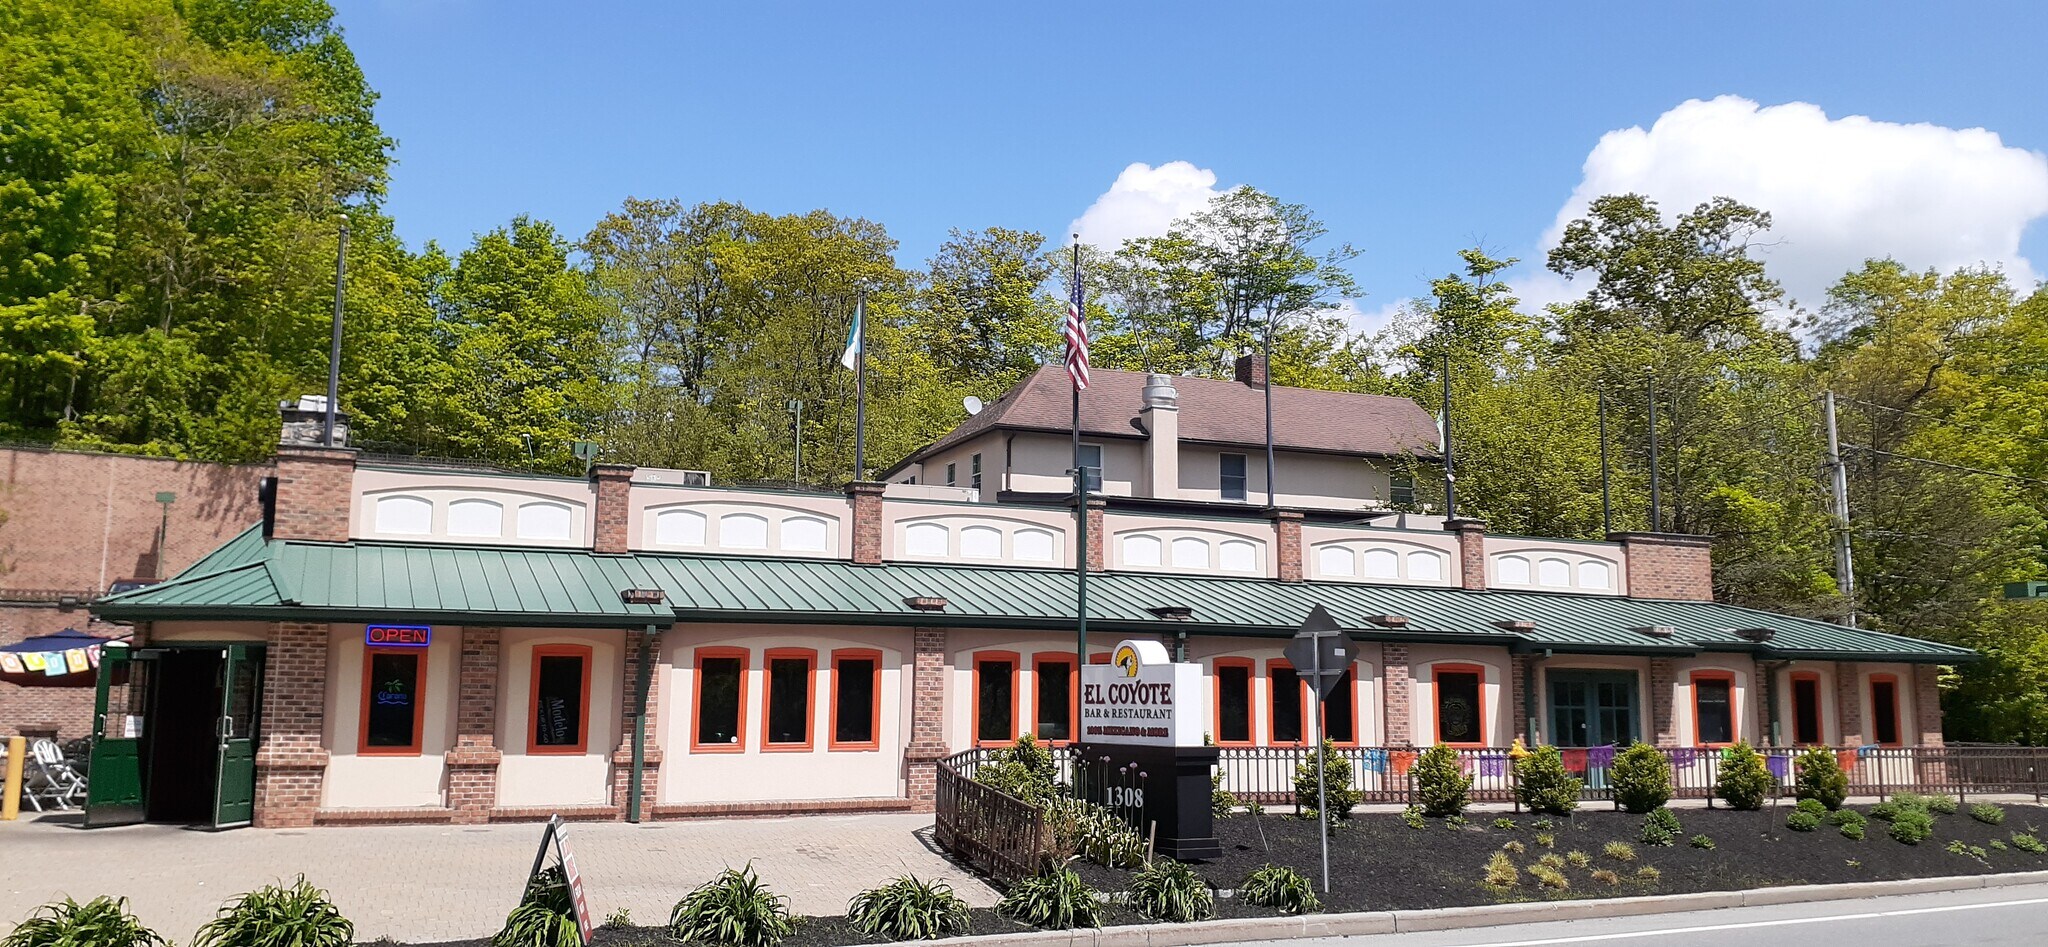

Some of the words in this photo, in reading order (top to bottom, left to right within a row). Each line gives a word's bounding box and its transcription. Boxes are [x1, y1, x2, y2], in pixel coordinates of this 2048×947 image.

[370, 628, 427, 643] OPEN
[1084, 684, 1106, 705] EL
[1108, 678, 1172, 705] COYOTE
[550, 699, 568, 738] Modelo
[1084, 708, 1102, 718] BAR
[1103, 709, 1110, 718] &
[1111, 708, 1172, 719] RESTAURANT
[1140, 727, 1147, 737] &
[1147, 727, 1169, 738] MORE
[1106, 786, 1144, 808] 1308
